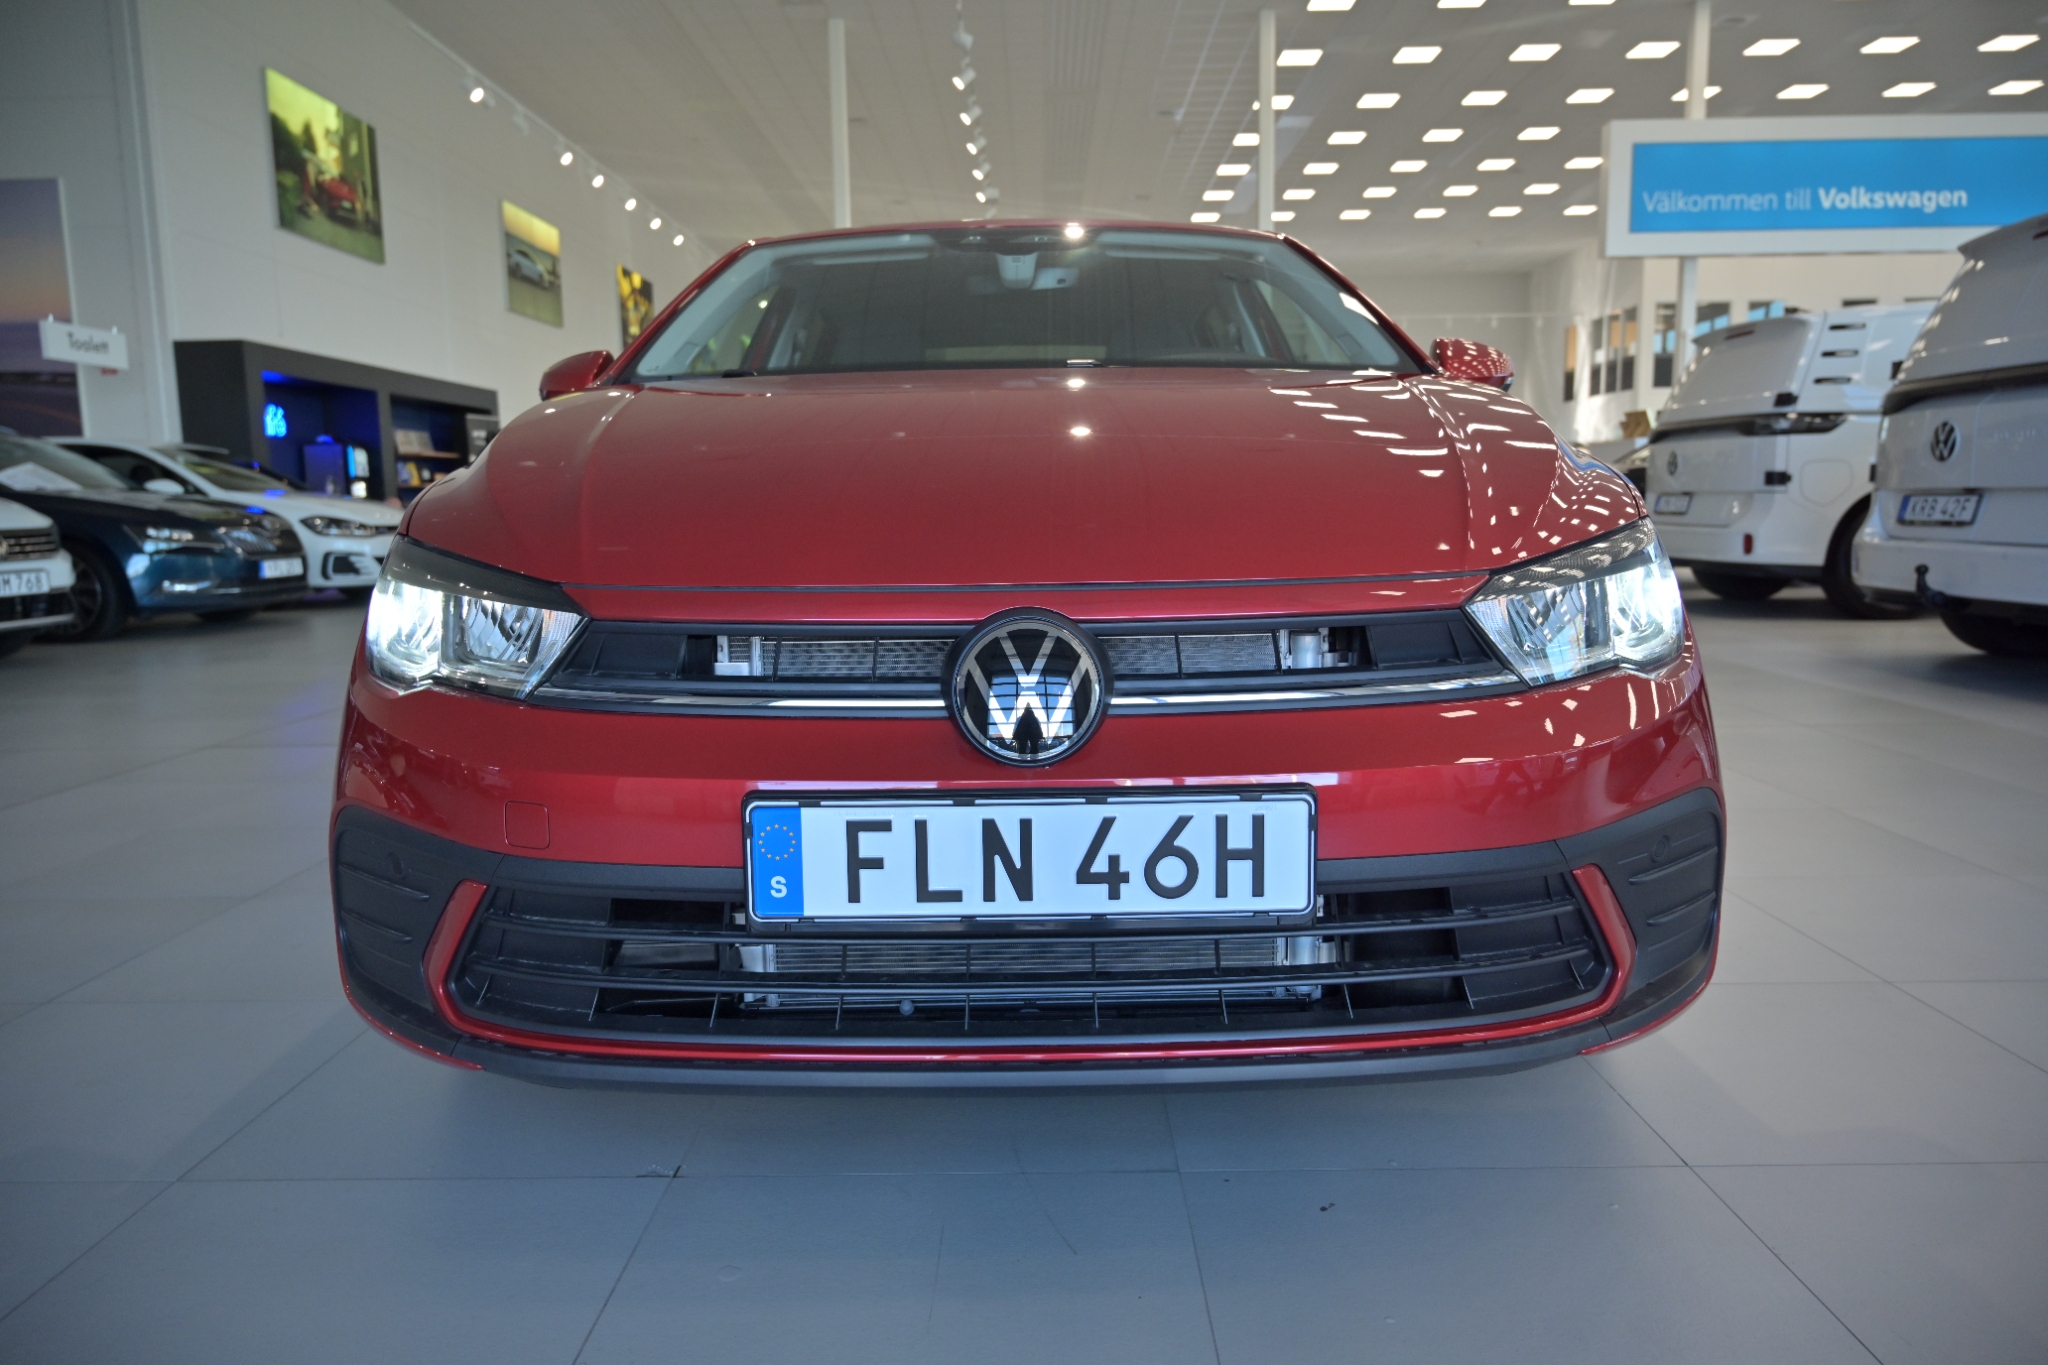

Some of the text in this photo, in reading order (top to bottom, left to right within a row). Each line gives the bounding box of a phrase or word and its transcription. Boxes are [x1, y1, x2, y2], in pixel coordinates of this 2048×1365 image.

[1643, 187, 1968, 213] Välkommen till Volkswagen
[67, 331, 110, 355] Toalett
[845, 814, 1266, 904] FLN 46H
[769, 875, 789, 899] S
